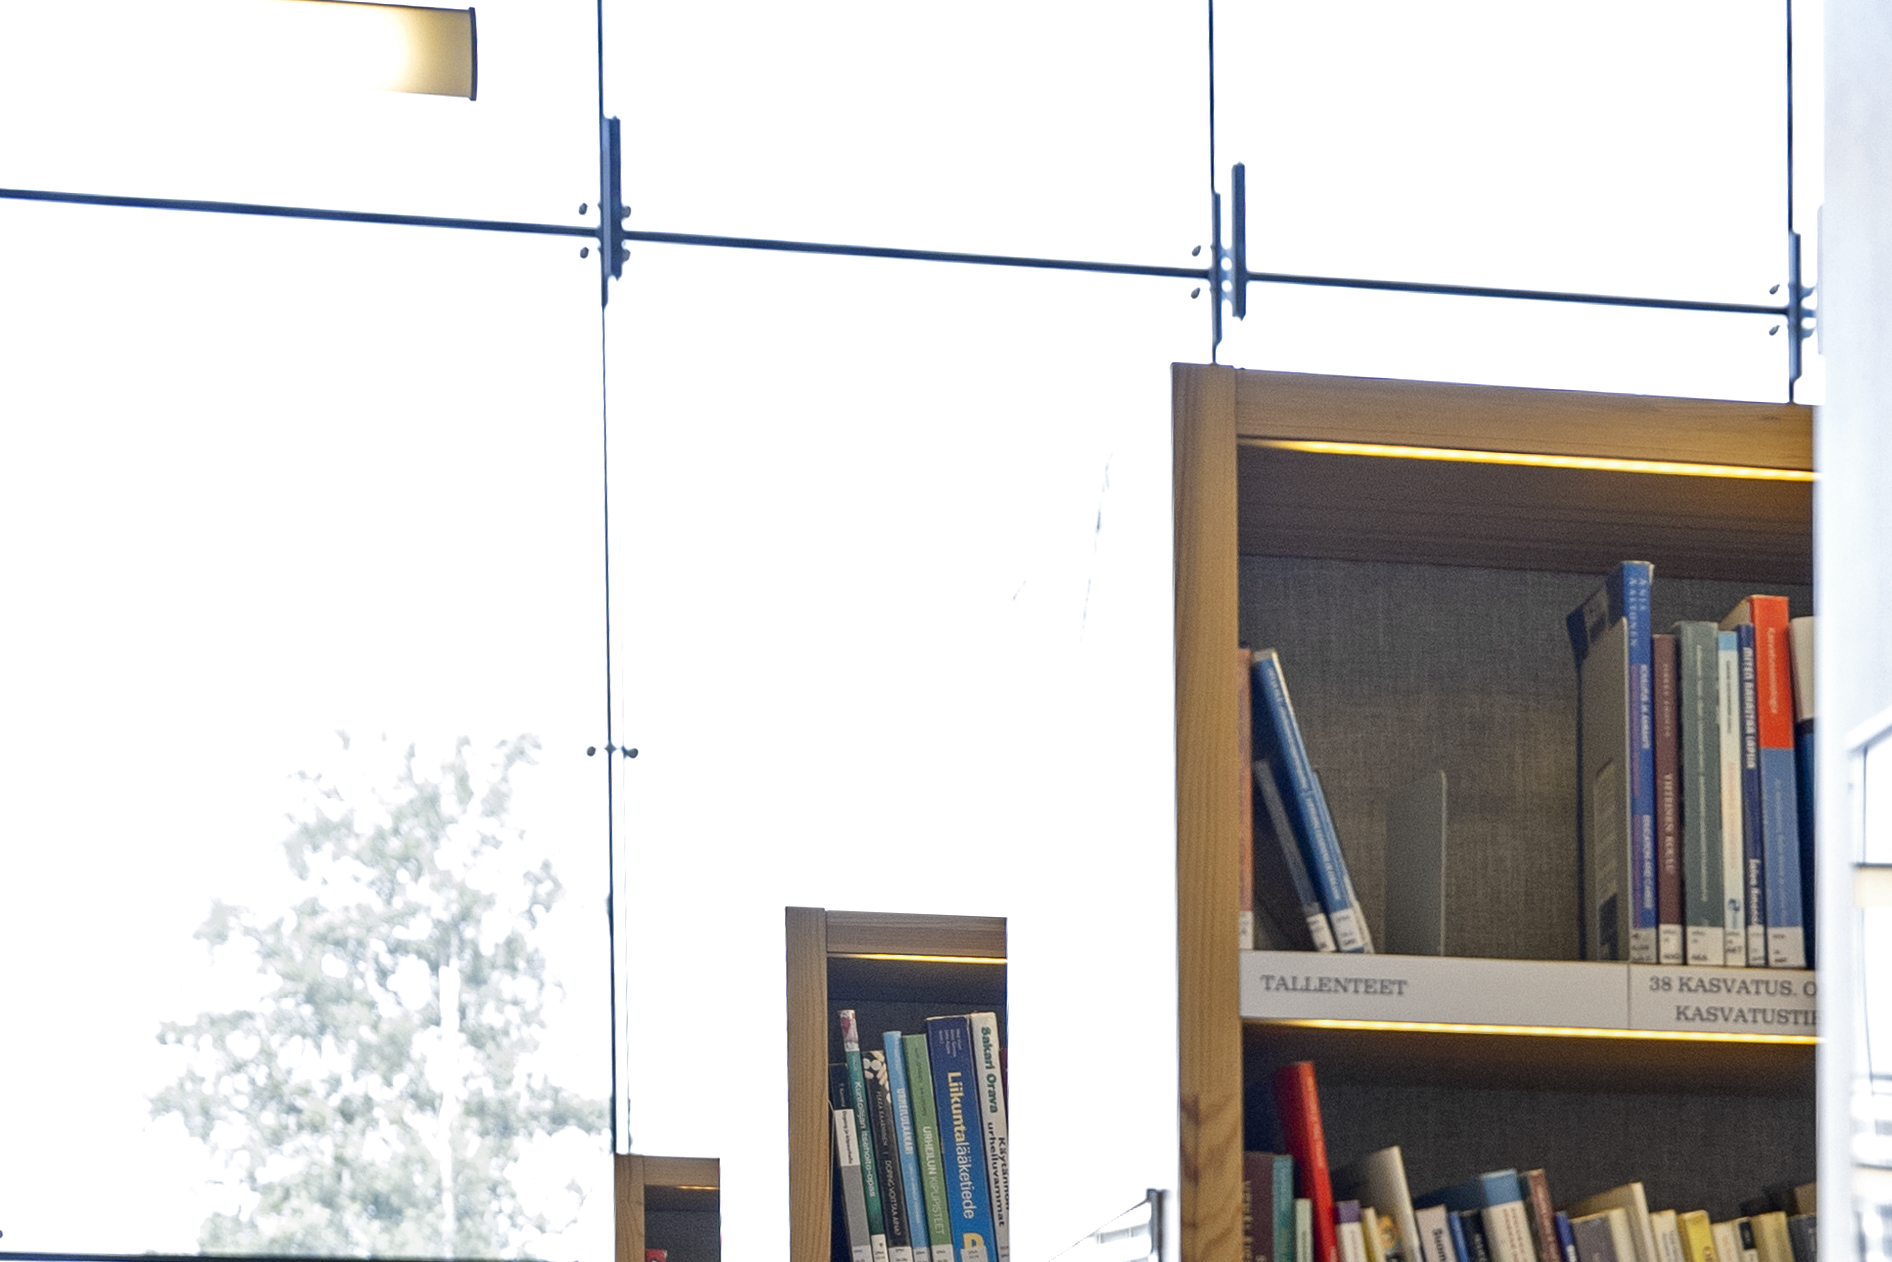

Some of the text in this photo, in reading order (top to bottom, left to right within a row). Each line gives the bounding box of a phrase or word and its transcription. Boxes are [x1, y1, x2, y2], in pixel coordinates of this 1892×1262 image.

[1259, 975, 1407, 996] TALLENTEET
[1649, 976, 1796, 995] 38 KASVATUS.
[981, 1027, 999, 1113] Sakari Orava
[884, 1160, 895, 1187] DOPING
[923, 1127, 945, 1235] URHEILUN KIPUPISTEET
[948, 1072, 977, 1219] Liikuntalääketiede
[987, 1123, 1005, 1227] urheiluvammat
